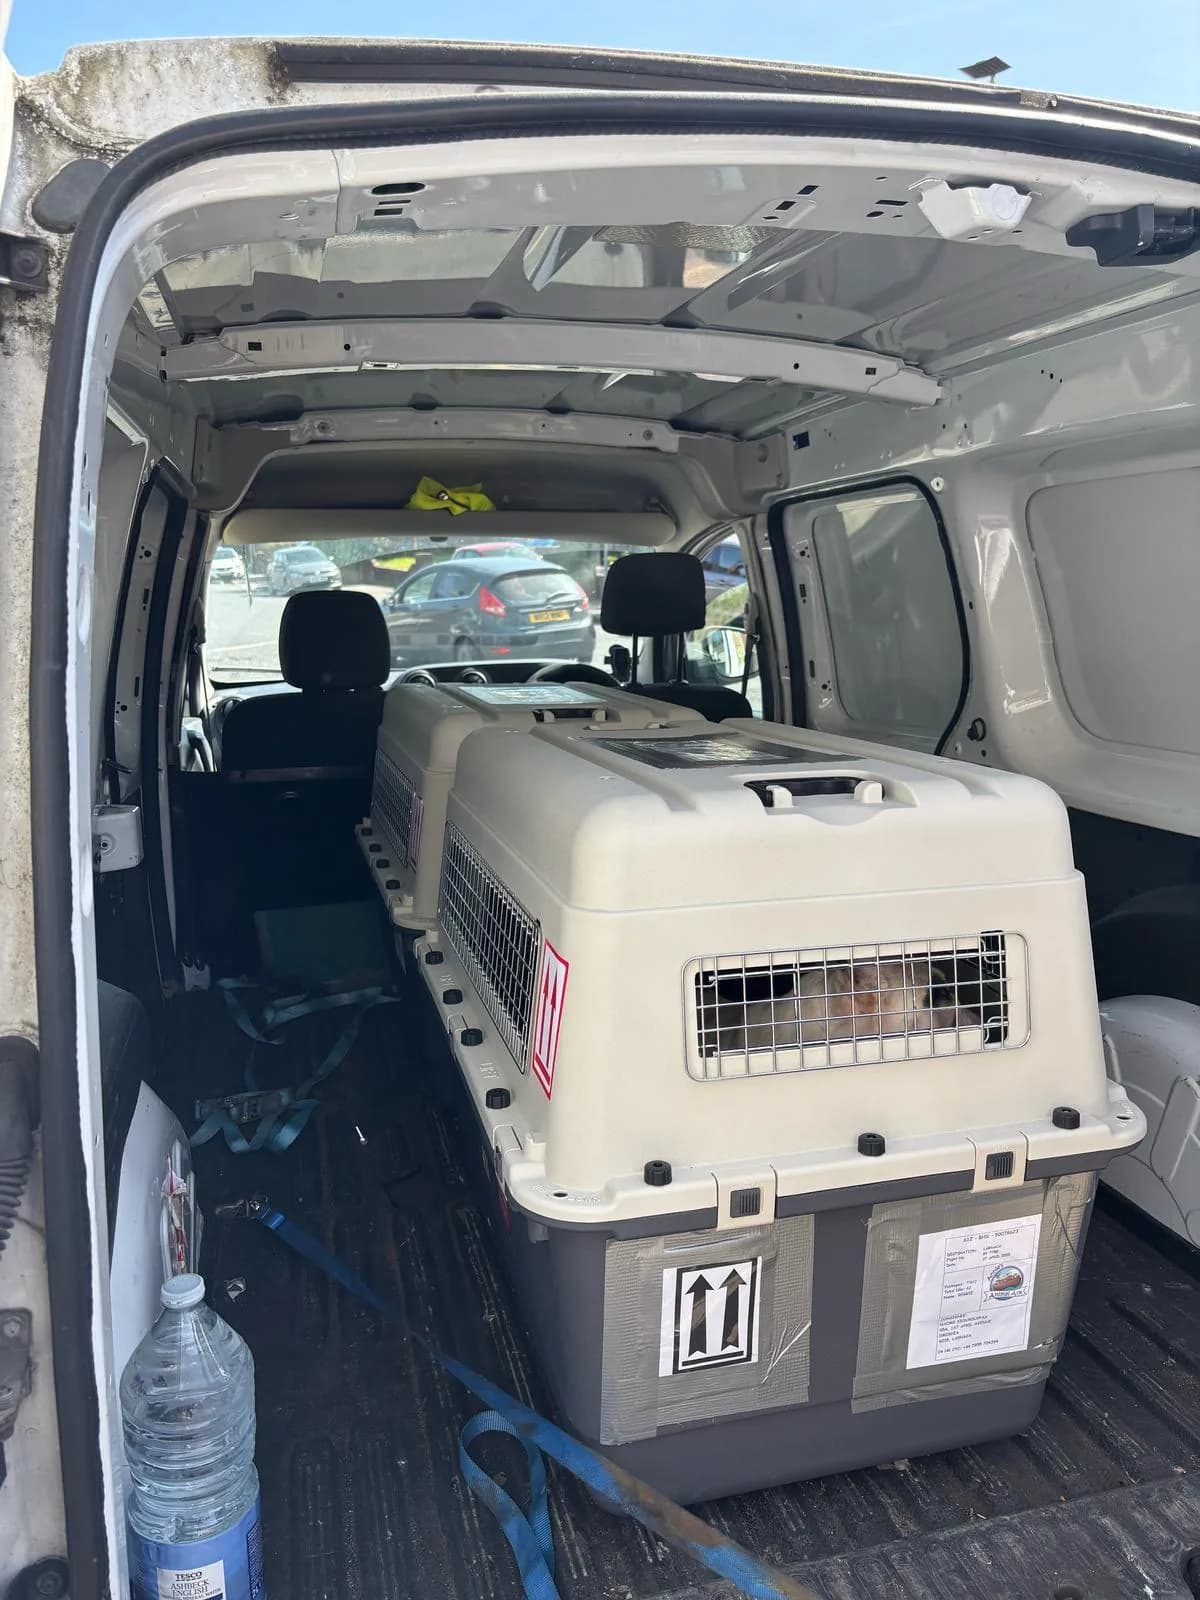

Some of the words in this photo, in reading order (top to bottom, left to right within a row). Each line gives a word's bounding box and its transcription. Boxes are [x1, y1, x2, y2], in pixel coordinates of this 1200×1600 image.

[175, 1571, 203, 1582] TESCO
[170, 1578, 210, 1591] ASHBECK
[172, 1586, 209, 1597] ENGLISH
